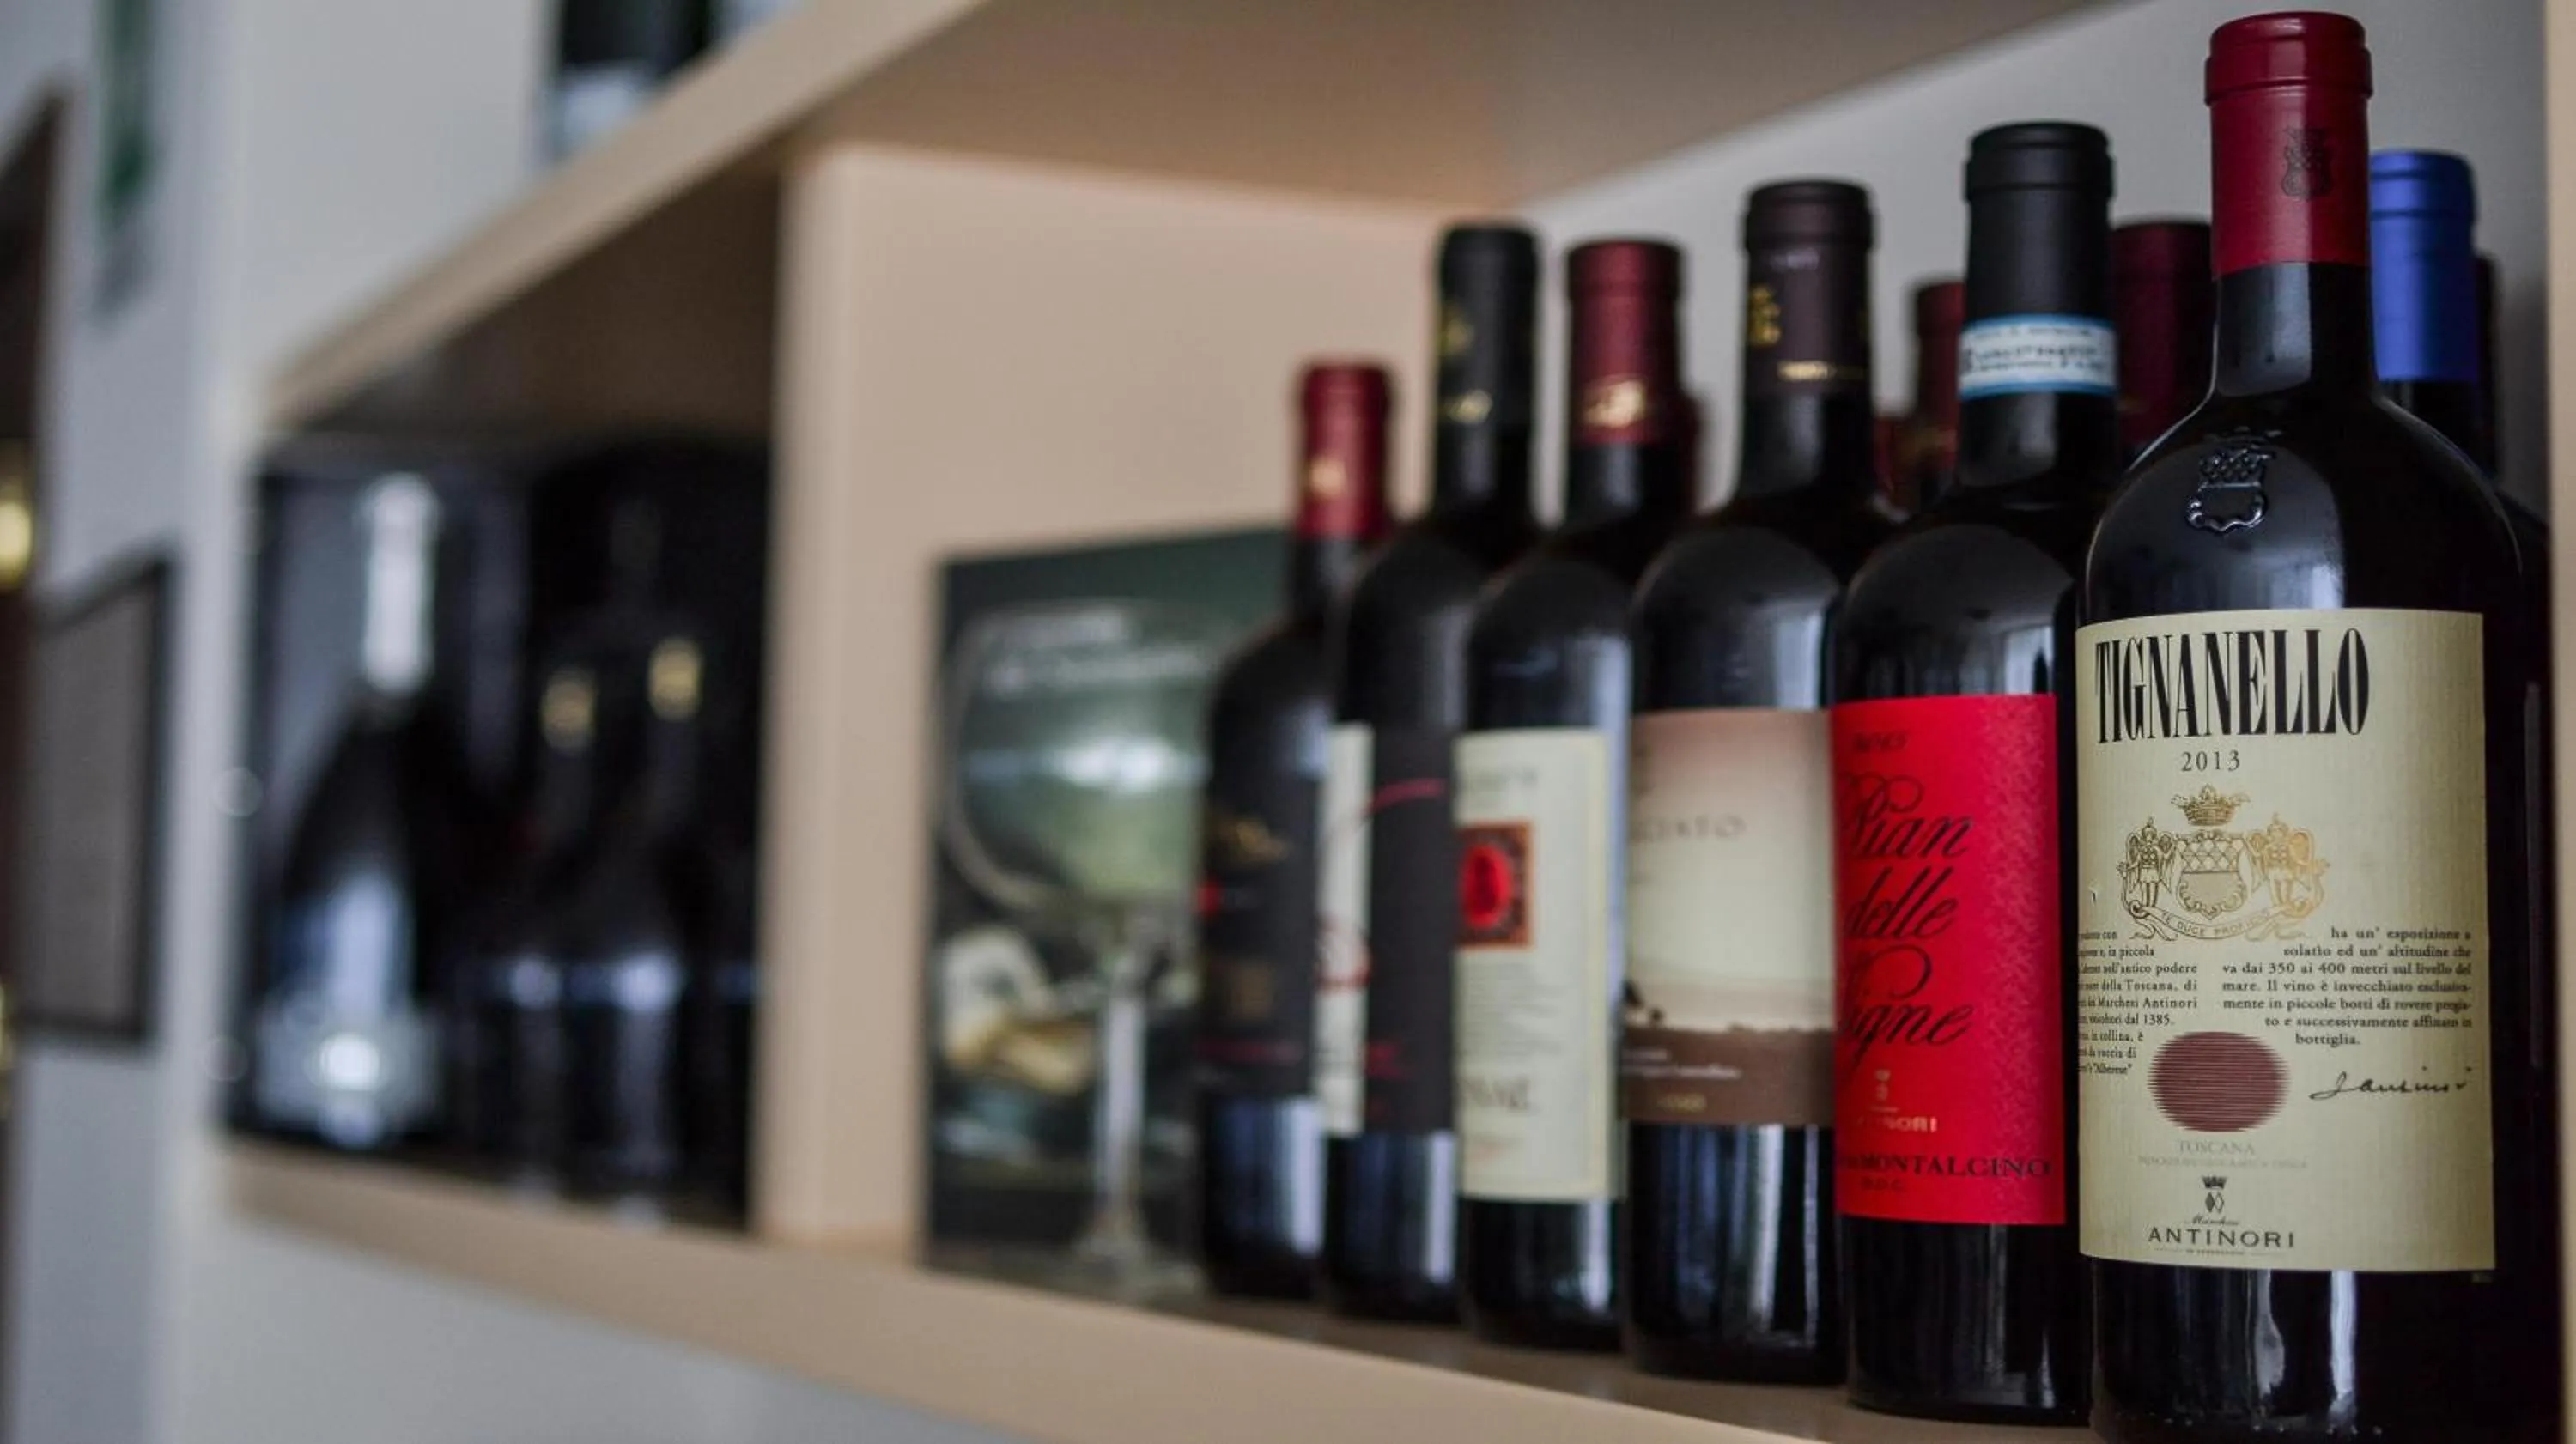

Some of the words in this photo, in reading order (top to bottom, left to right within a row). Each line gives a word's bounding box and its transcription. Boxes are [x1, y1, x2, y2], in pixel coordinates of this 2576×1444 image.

[2095, 628, 2370, 743] TIGNANELLO
[2181, 750, 2241, 772] 2013
[1844, 865, 1959, 939] delle
[2331, 926, 2348, 938] ha
[2355, 926, 2380, 939] un'
[2386, 927, 2460, 943] esposizione
[2119, 944, 2154, 961] piccola
[2336, 944, 2353, 956] ed
[2359, 944, 2383, 956] un'
[2388, 944, 2449, 956] altitudine
[2452, 946, 2471, 956] che
[2156, 962, 2197, 977] podere
[2222, 965, 2237, 974] va
[2242, 962, 2263, 974] dai
[2268, 962, 2295, 974] 350
[2300, 962, 2312, 974] ai
[2318, 962, 2346, 974] 400
[2351, 962, 2388, 974] metri
[2393, 962, 2412, 974] sul
[2415, 962, 2452, 974] livello
[2455, 962, 2472, 974] del
[2184, 980, 2197, 991] di
[2222, 982, 2261, 991] mare.
[2267, 979, 2277, 991] Il
[2283, 980, 2315, 991] vino
[2321, 980, 2329, 991] è
[2334, 980, 2413, 992] invecchiato
[2143, 997, 2197, 1009] Antinori
[2223, 1000, 2265, 1009] mente
[2269, 998, 2282, 1009] in
[2287, 997, 2336, 1012] piccole
[2340, 997, 2373, 1009] botti
[2377, 998, 2390, 1009] di
[2394, 1001, 2433, 1010] rovere
[2125, 1013, 2139, 1024] dal
[2264, 1016, 2279, 1026] to
[2296, 1015, 2409, 1027] successivamente
[2412, 1013, 2458, 1027] affinato
[2462, 1017, 2472, 1027] in
[2295, 1033, 2360, 1048] bottiglia.
[2127, 1047, 2137, 1058] di
[2148, 1226, 2294, 1248] ANTINORI
